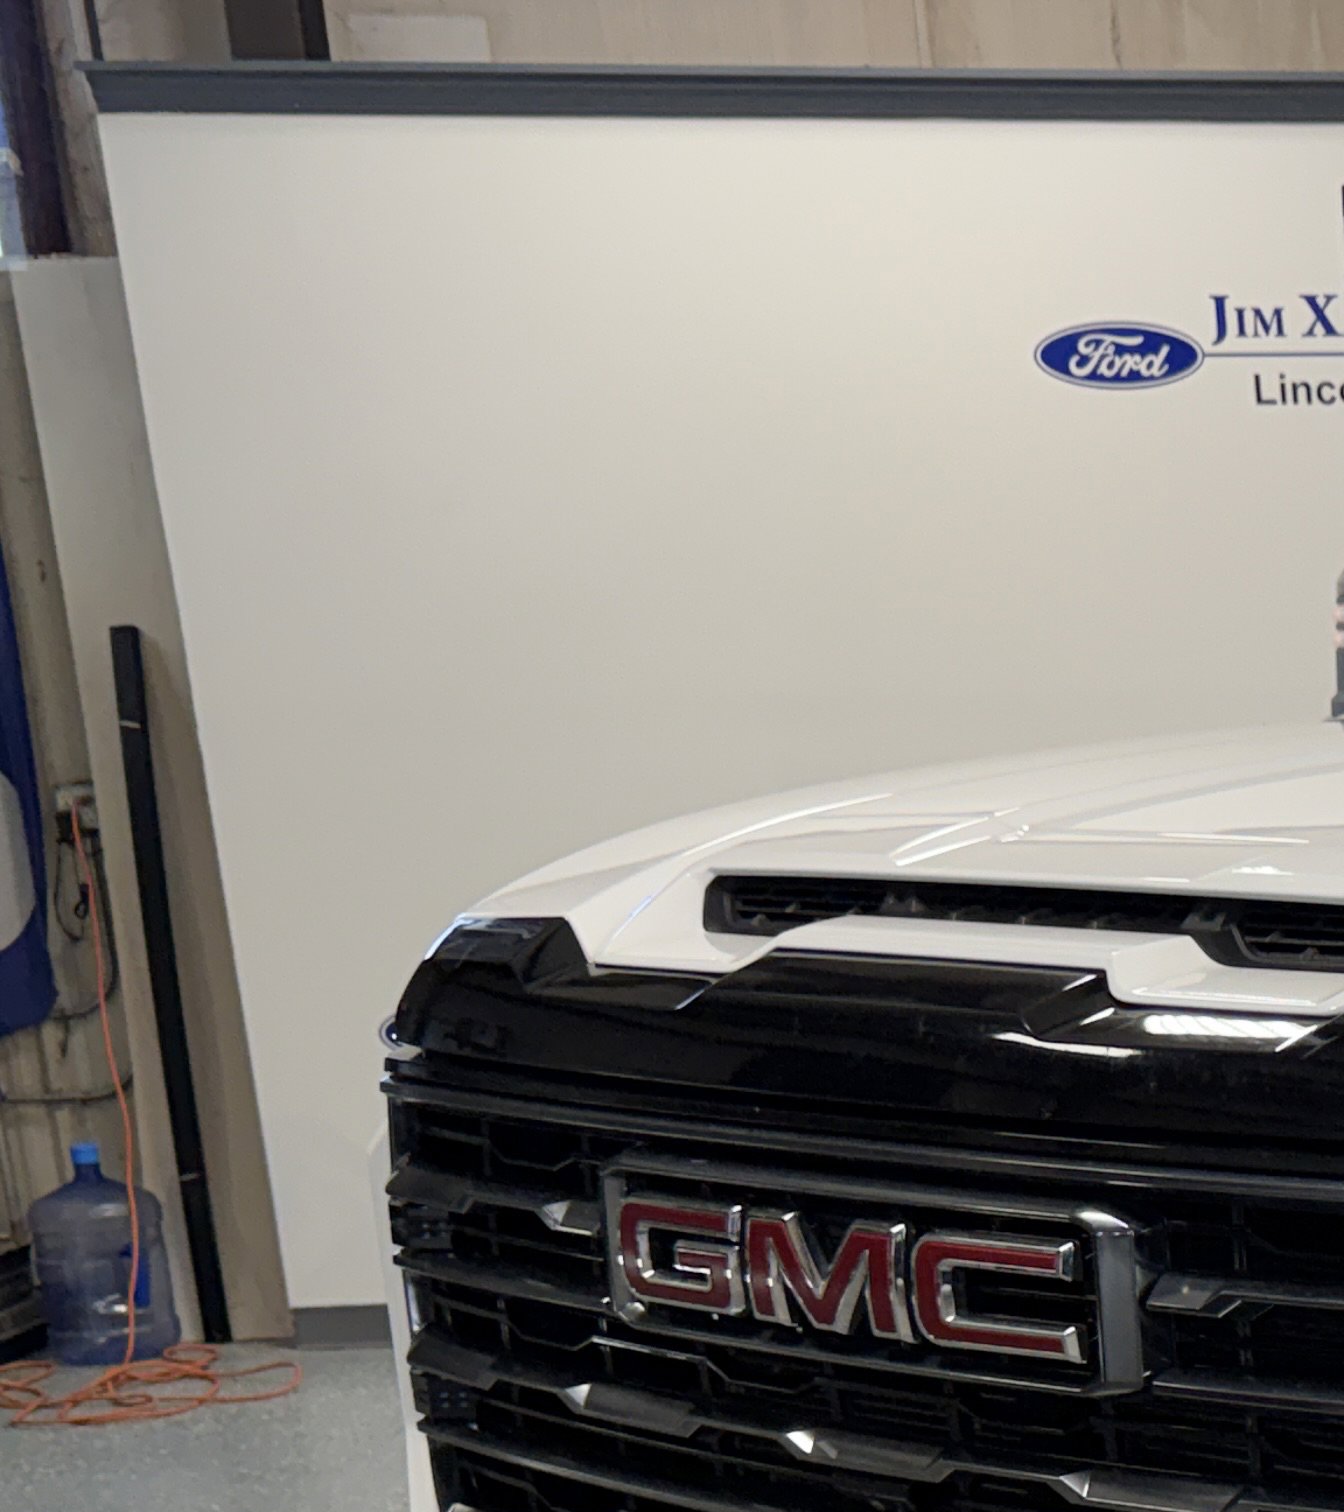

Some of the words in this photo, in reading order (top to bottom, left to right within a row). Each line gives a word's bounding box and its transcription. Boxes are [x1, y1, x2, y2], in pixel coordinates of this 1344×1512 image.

[1209, 295, 1287, 345] JIM
[1068, 335, 1170, 379] Ford
[619, 1201, 1088, 1365] GMC
